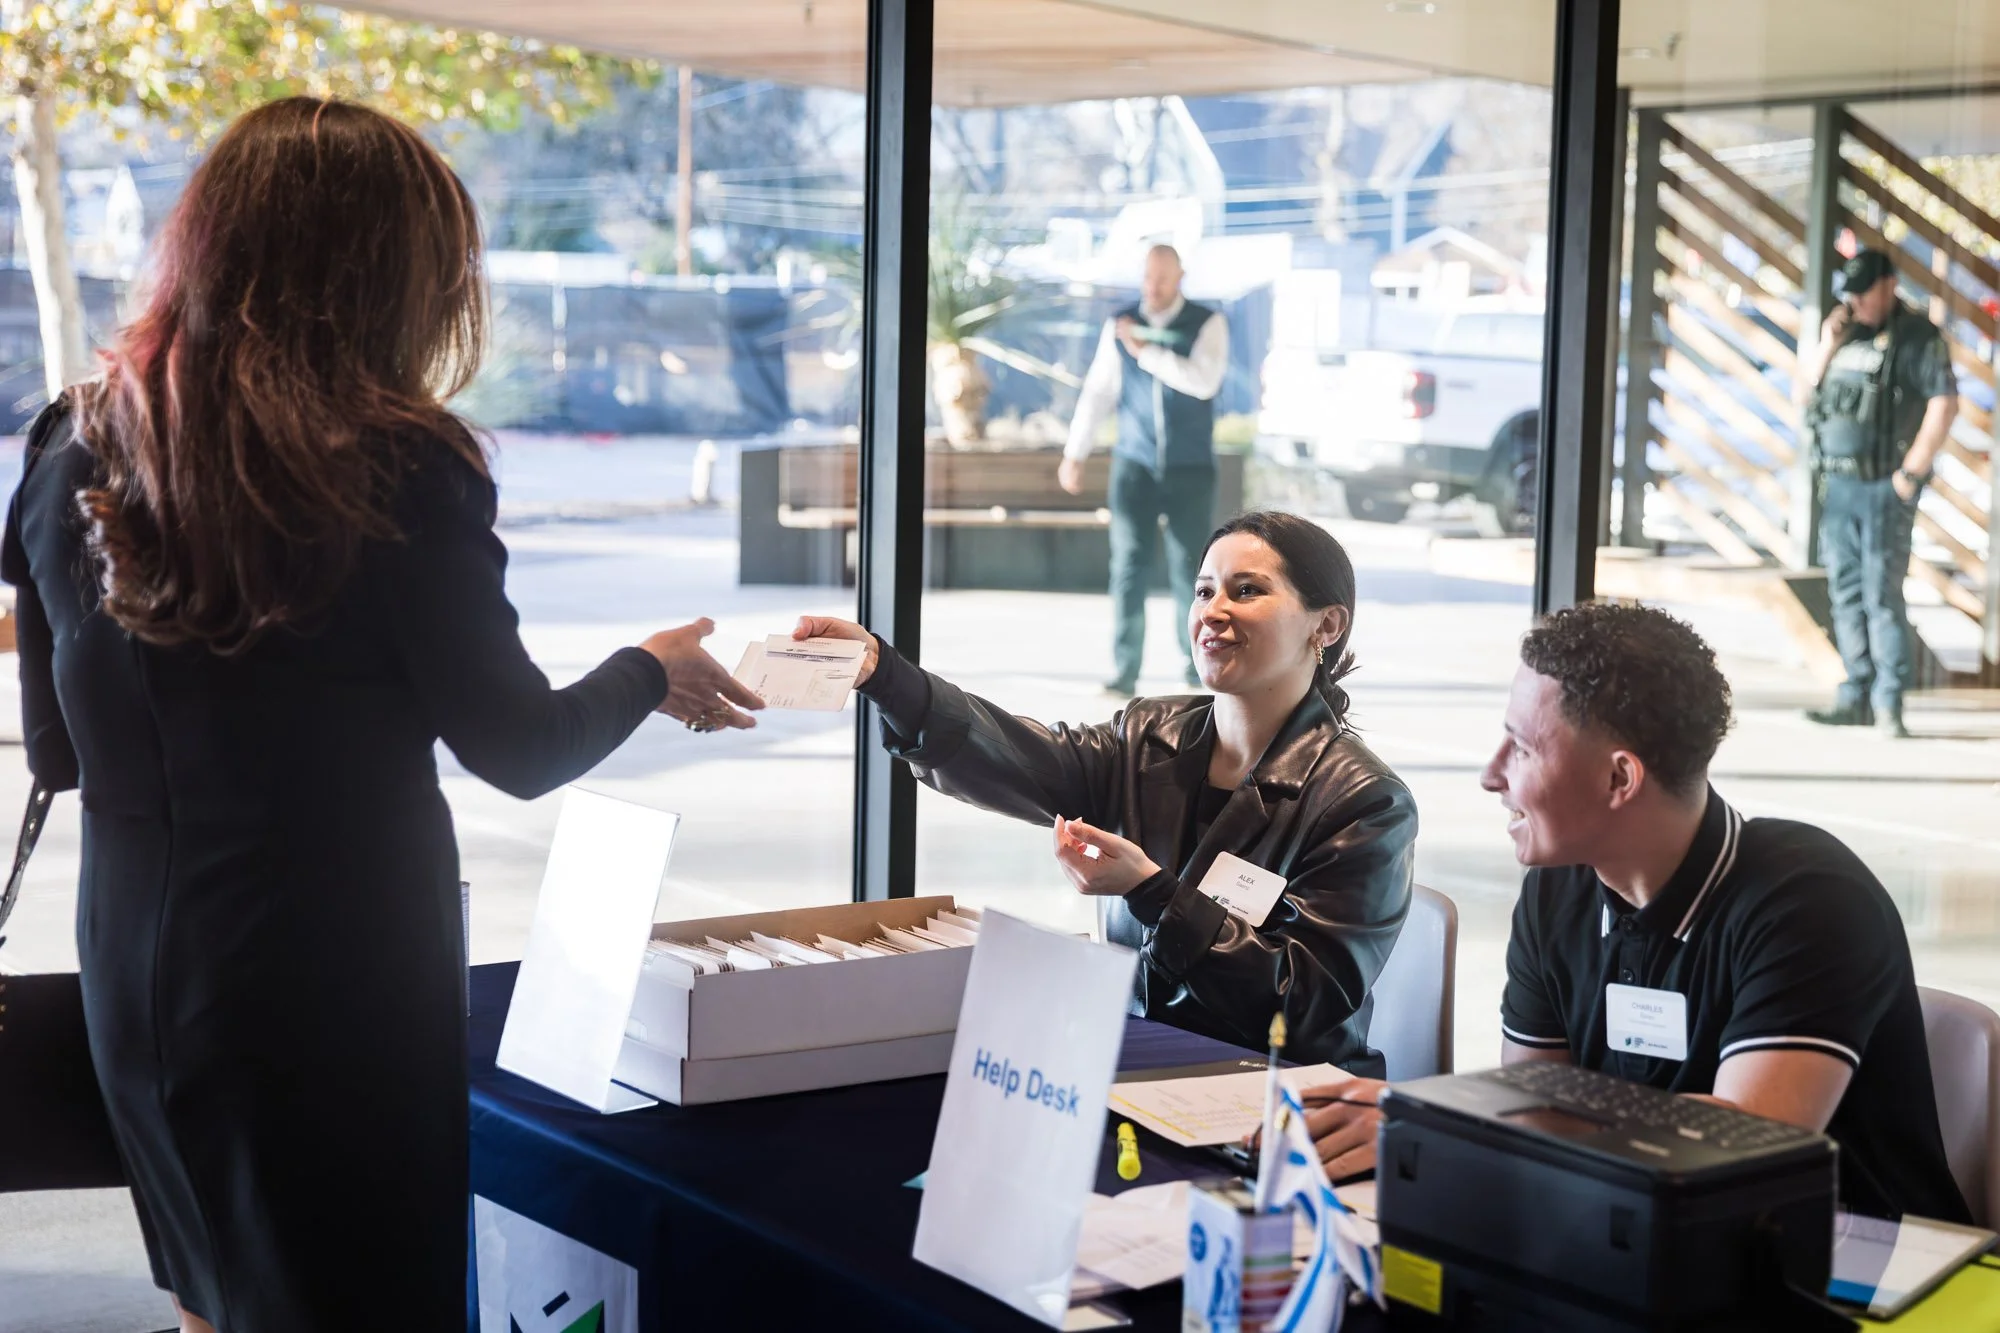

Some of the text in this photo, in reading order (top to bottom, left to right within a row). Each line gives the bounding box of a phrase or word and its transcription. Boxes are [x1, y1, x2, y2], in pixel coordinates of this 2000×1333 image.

[1238, 874, 1256, 885] ALEX
[973, 1047, 1081, 1117] Help Desk
